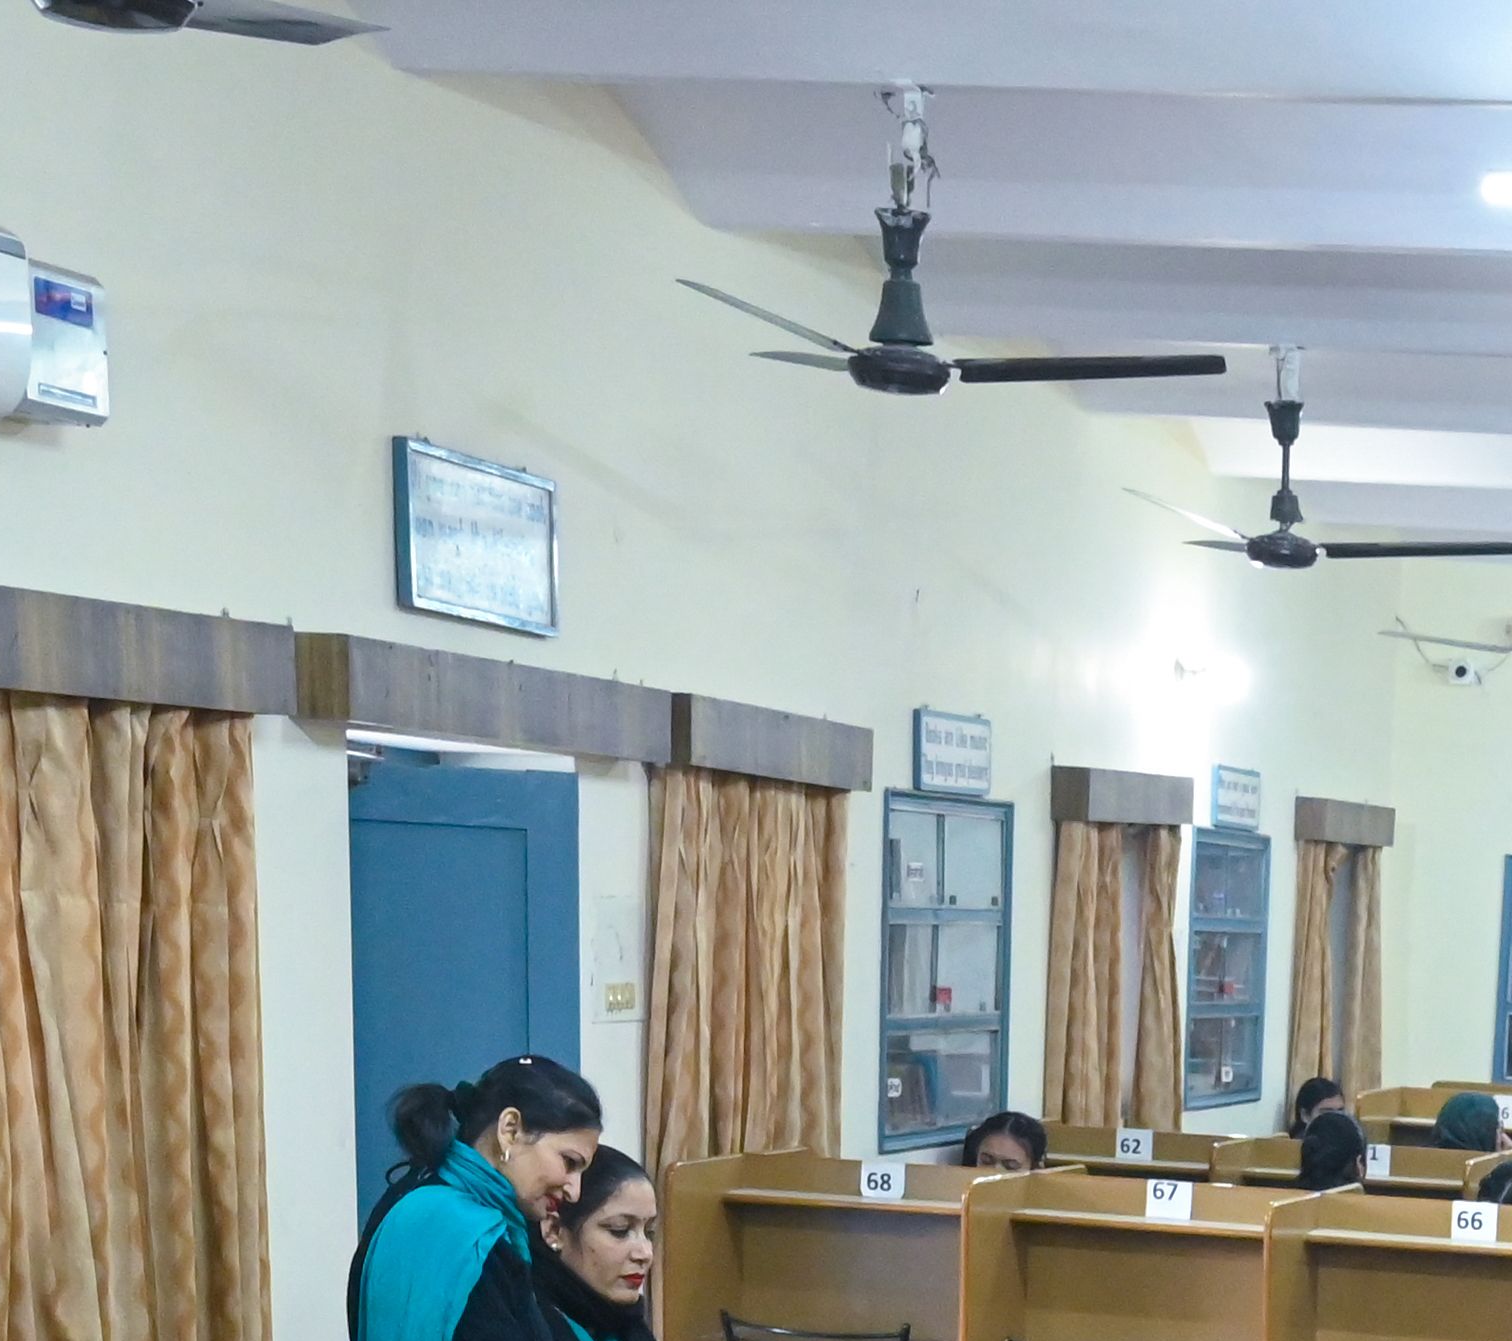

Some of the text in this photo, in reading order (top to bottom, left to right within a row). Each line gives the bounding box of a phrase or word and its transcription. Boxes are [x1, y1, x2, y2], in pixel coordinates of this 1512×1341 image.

[1120, 1138, 1141, 1154] 62
[866, 1172, 892, 1192] 68
[1152, 1181, 1178, 1201] 67
[1456, 1210, 1483, 1230] 66
